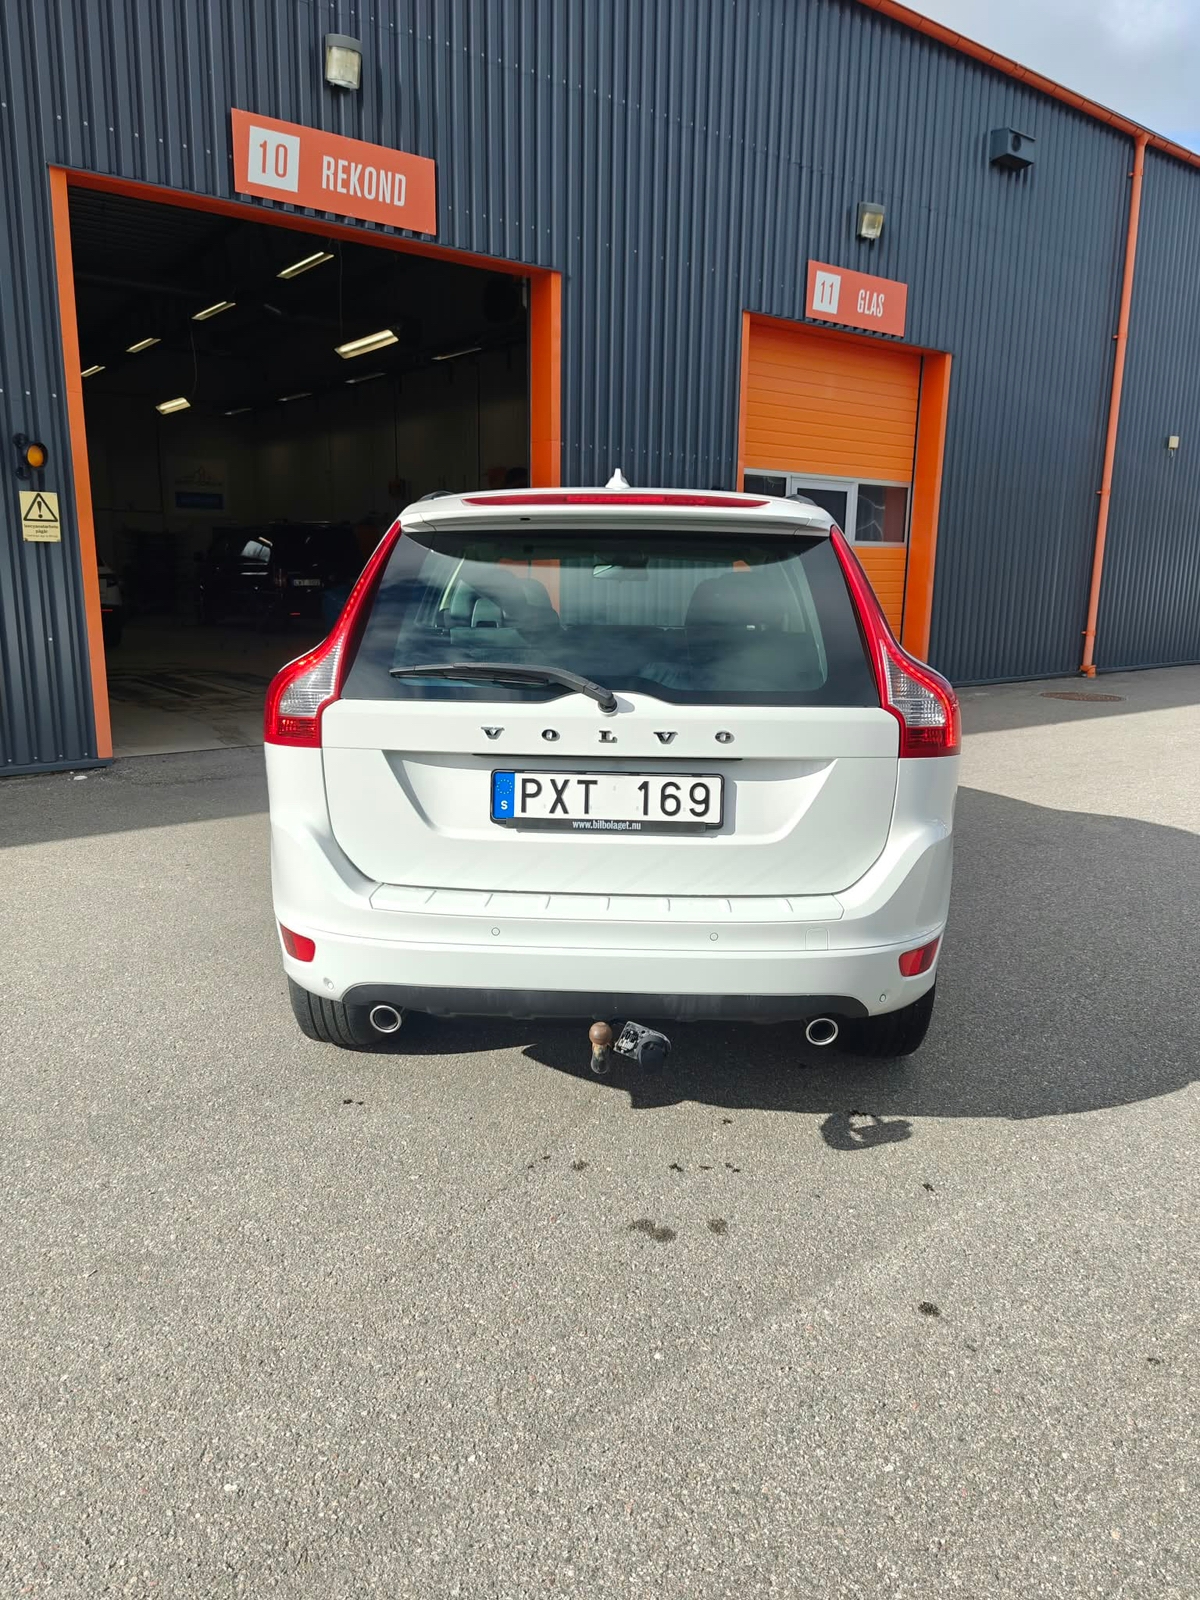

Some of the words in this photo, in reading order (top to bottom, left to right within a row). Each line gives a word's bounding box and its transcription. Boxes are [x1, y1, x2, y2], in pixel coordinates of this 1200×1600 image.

[259, 139, 289, 179] 10
[321, 155, 407, 207] REKOND
[820, 280, 834, 305] 11
[857, 289, 885, 317] GLAS
[480, 726, 735, 745] VOLVO
[500, 800, 508, 810] S
[521, 778, 598, 815] PXT
[637, 780, 711, 817] 169
[572, 820, 641, 831] www.bilbolaget.nu
